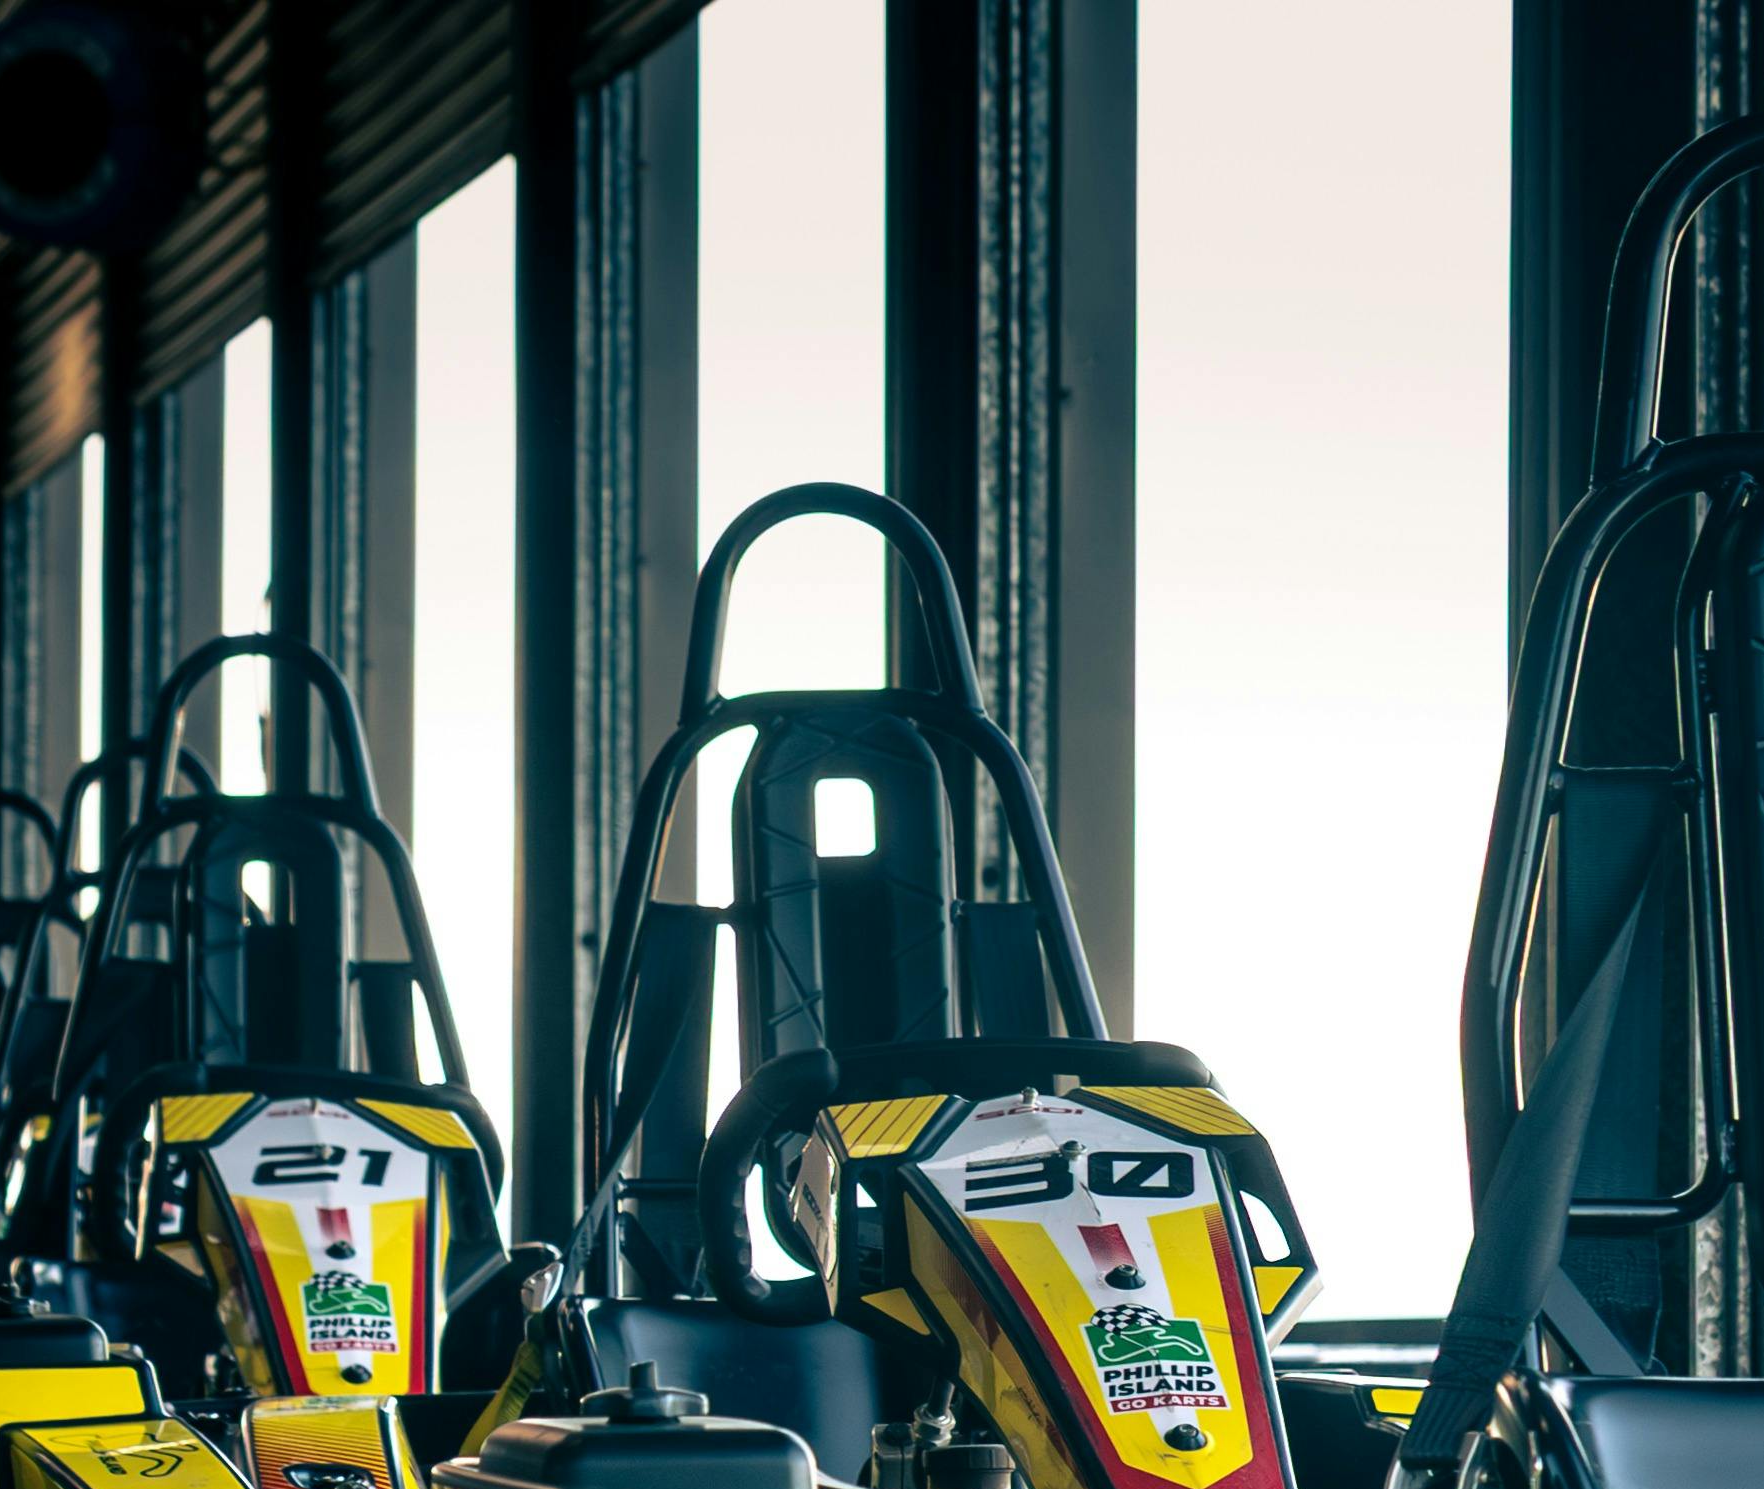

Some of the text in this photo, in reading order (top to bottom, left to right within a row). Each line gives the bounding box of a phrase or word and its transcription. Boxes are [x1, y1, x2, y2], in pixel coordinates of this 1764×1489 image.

[974, 1106, 1084, 1121] SODI
[252, 1143, 393, 1186] 21
[964, 1149, 1195, 1212] 30
[309, 1317, 393, 1329] PHILLIP
[310, 1328, 392, 1340] ISLAND
[1103, 1364, 1214, 1383] PHILLIP
[1108, 1379, 1216, 1398] ISLAND
[1117, 1395, 1220, 1411] GO KARTS
